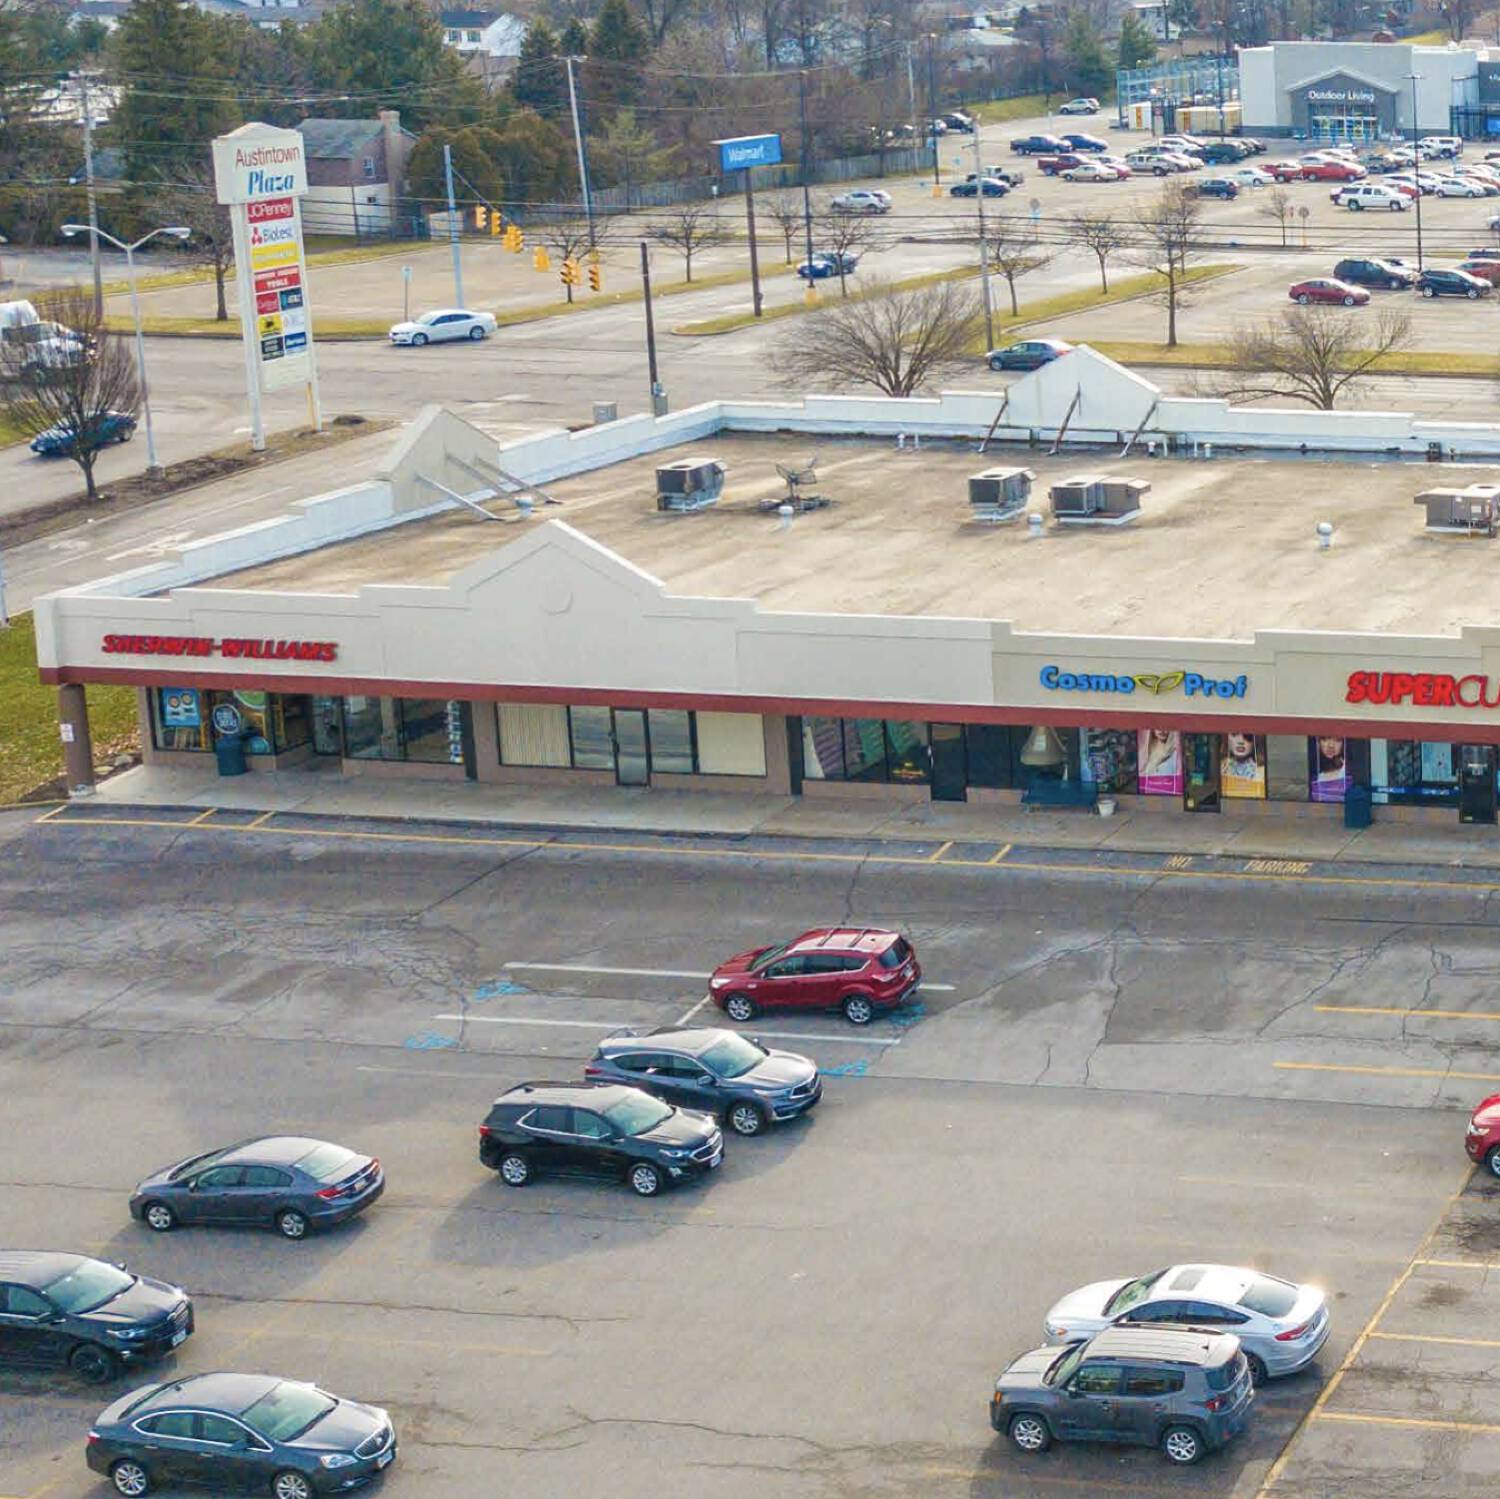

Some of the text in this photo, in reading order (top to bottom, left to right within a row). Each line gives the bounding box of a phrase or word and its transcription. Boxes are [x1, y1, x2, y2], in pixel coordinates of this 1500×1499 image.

[1308, 90, 1374, 103] Outdoor Living
[235, 147, 300, 169] Austintown
[728, 144, 764, 162] Walmart
[248, 170, 294, 195] Plaza
[249, 203, 291, 218] JCPenney
[102, 634, 339, 662] SHERWIN-WILLIAMS
[1040, 665, 1248, 699] Cosmo Prof
[1166, 854, 1314, 875] NO PARKING
